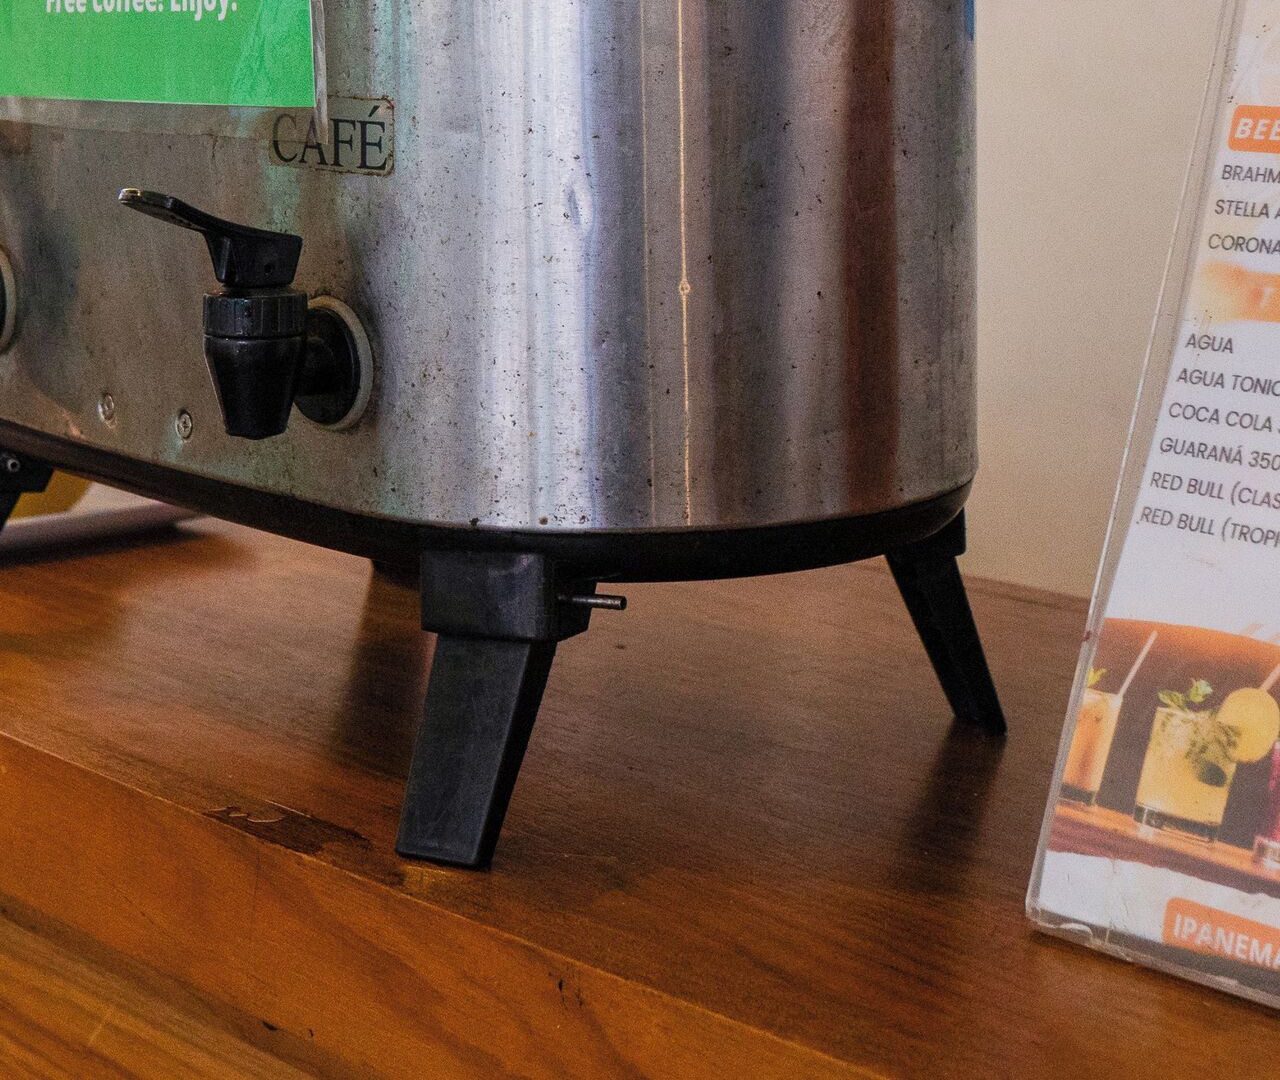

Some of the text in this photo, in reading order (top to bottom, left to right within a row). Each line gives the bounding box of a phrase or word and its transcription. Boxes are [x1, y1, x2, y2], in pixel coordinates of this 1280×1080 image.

[272, 105, 387, 170] CAFÉ
[1215, 199, 1270, 219] STELLA
[1185, 334, 1234, 354] AGUA
[1177, 368, 1224, 390] AGUA
[1169, 402, 1220, 425] COCA
[1225, 410, 1272, 433] COLA
[1160, 436, 1243, 466] GUARANÁ
[1150, 472, 1182, 491] RED
[1186, 478, 1224, 500] BULL
[1140, 506, 1174, 526] RED
[1178, 514, 1215, 536] BULL
